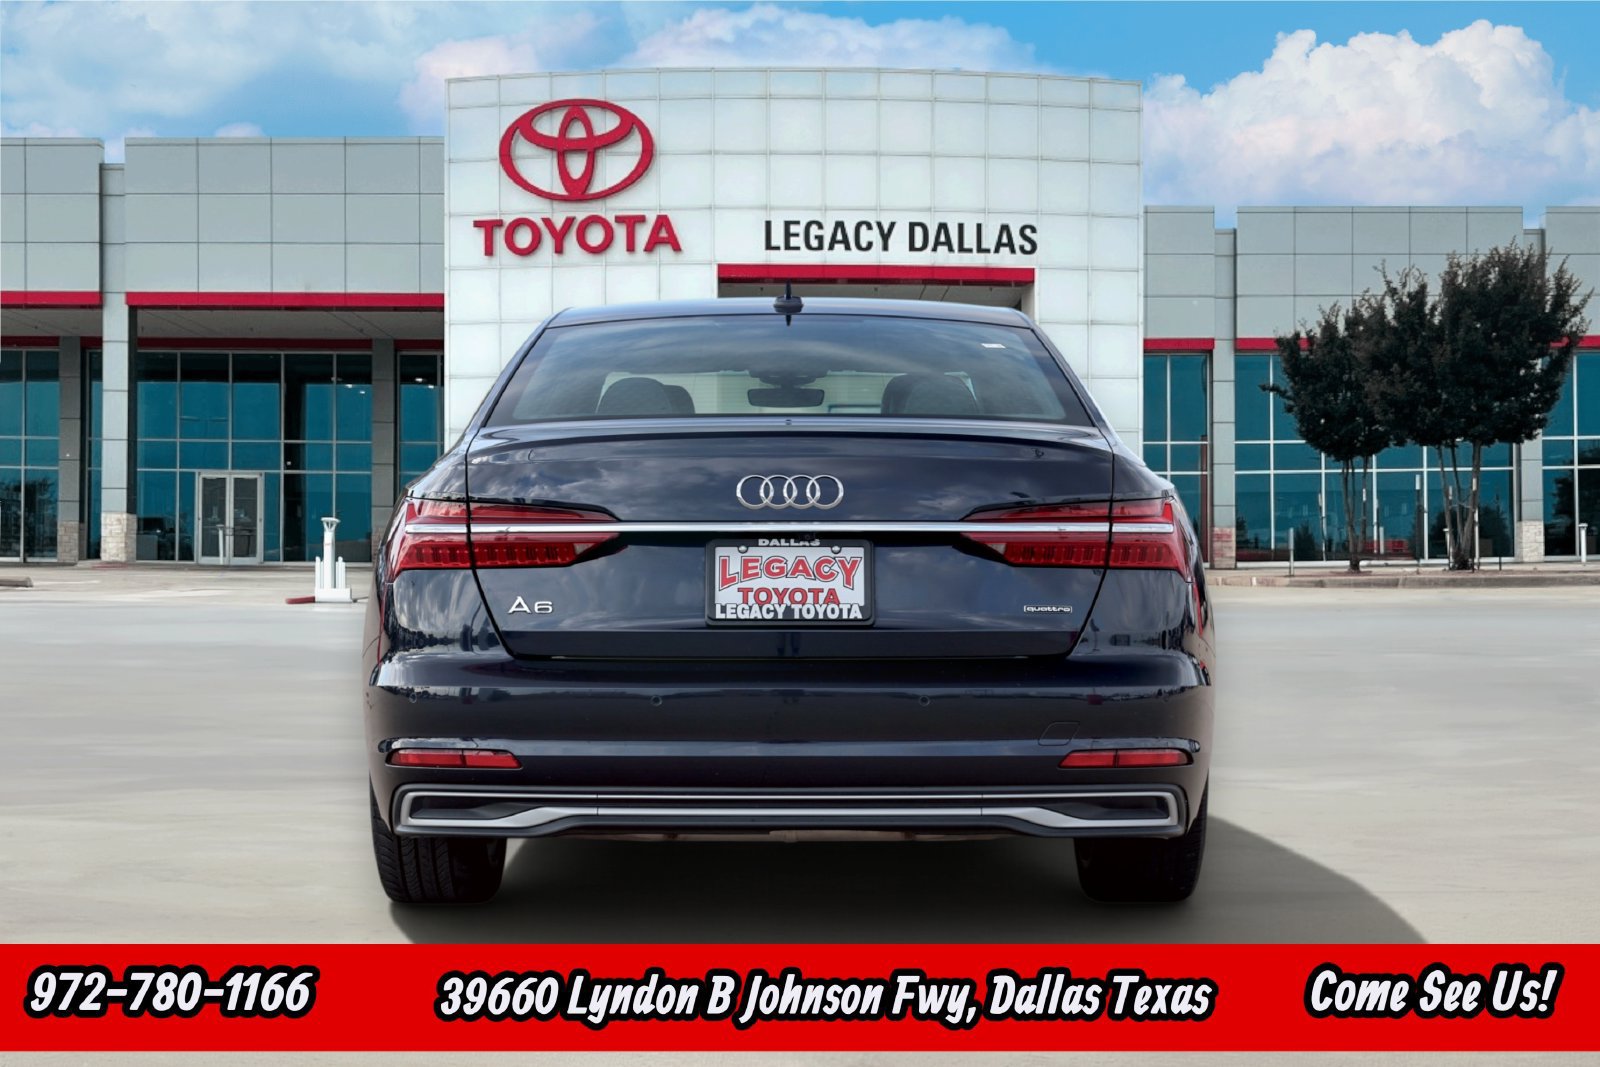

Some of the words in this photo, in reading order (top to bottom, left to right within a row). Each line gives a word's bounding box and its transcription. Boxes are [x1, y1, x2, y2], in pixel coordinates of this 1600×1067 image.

[474, 214, 681, 256] TOYOTA
[764, 220, 896, 252] LEGACY
[908, 221, 1038, 255] DALLAS
[758, 538, 821, 546] DALLAS
[718, 556, 862, 591] LEGACY
[507, 595, 553, 614] A6
[737, 587, 841, 606] TOYOTA
[715, 603, 787, 619] LEGACY
[793, 603, 863, 619] TOYOTA
[1025, 605, 1072, 613] quattro
